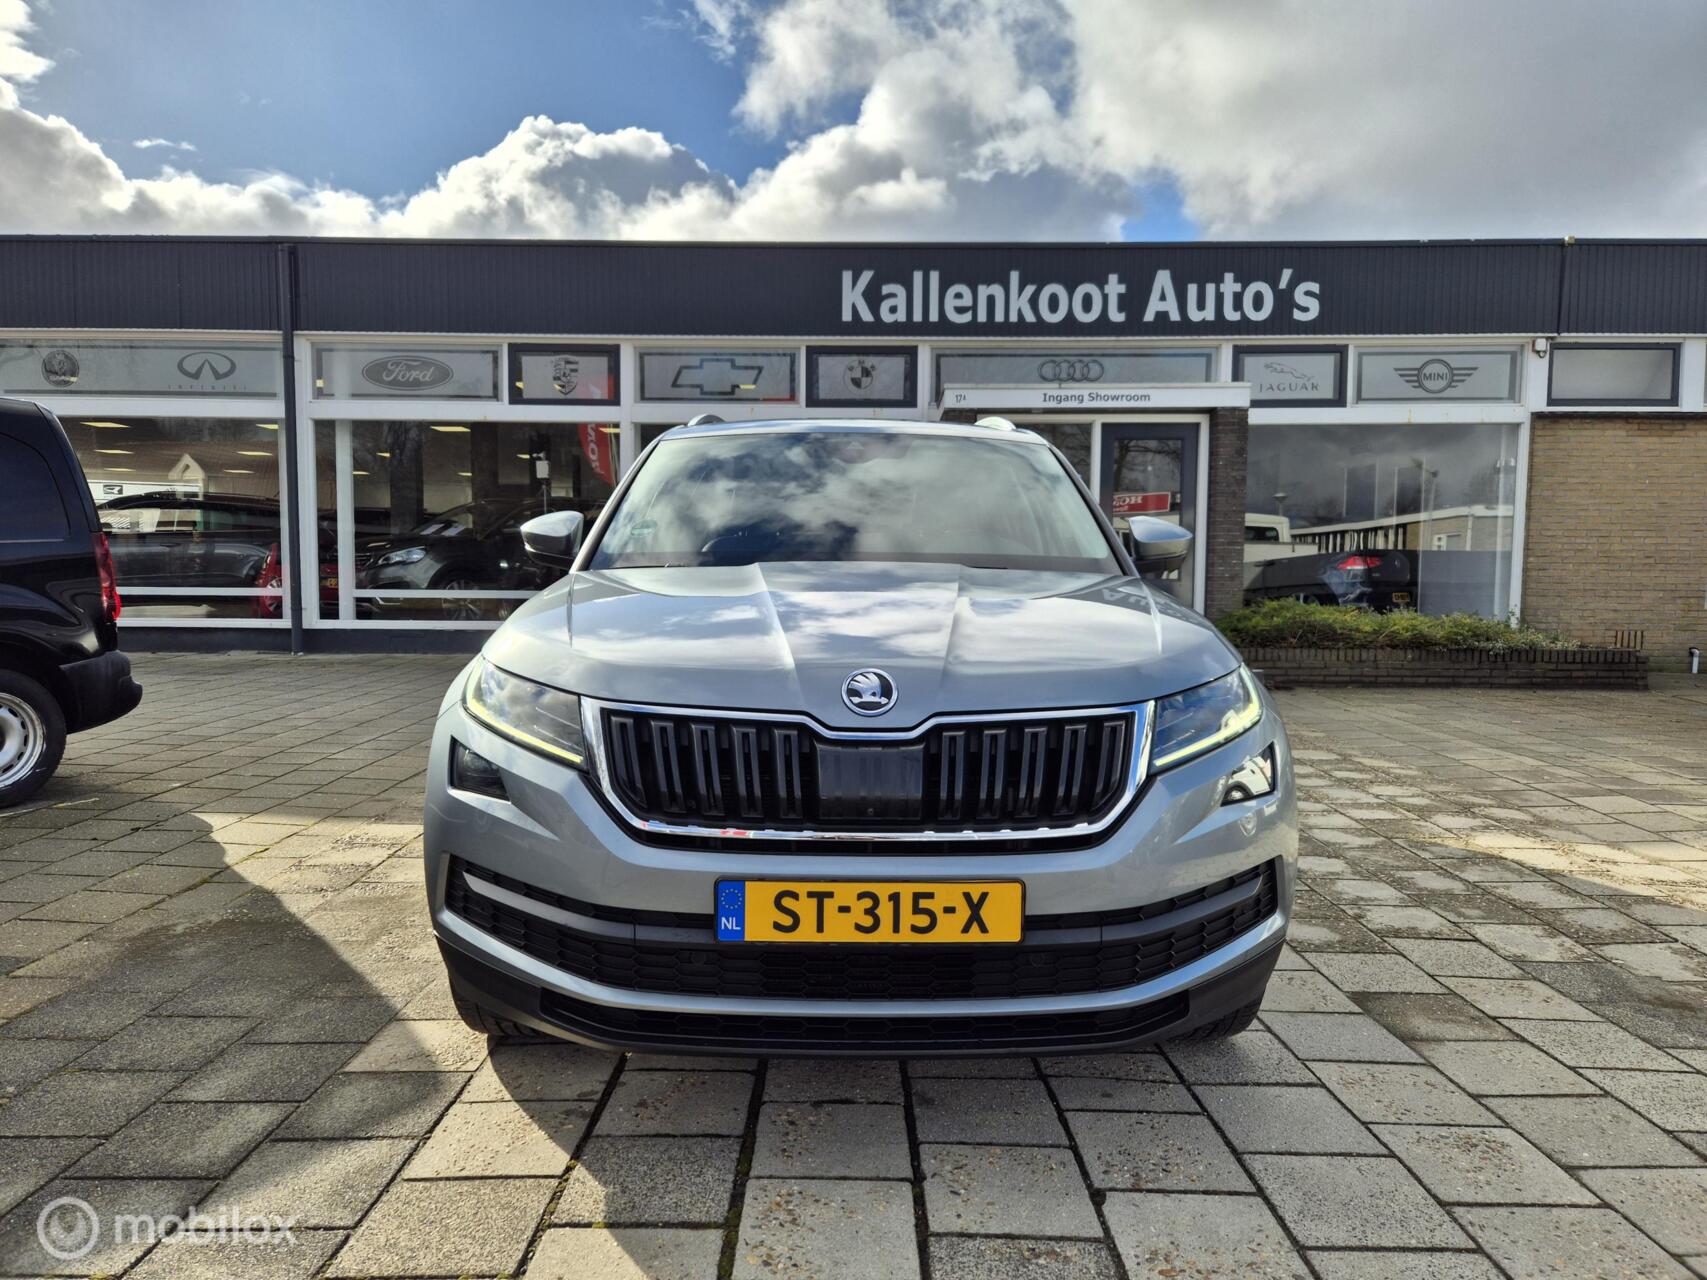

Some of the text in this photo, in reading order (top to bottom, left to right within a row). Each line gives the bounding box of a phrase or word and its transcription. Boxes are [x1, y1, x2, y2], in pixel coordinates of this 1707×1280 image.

[841, 268, 1320, 324] Kallenkoot Auto's
[382, 360, 434, 382] Ford
[1422, 372, 1449, 382] MINI
[1259, 382, 1320, 393] JAGUAR
[1042, 392, 1151, 404] Ingang Showroom
[772, 890, 990, 934] ST-315-X
[721, 917, 741, 930] NL
